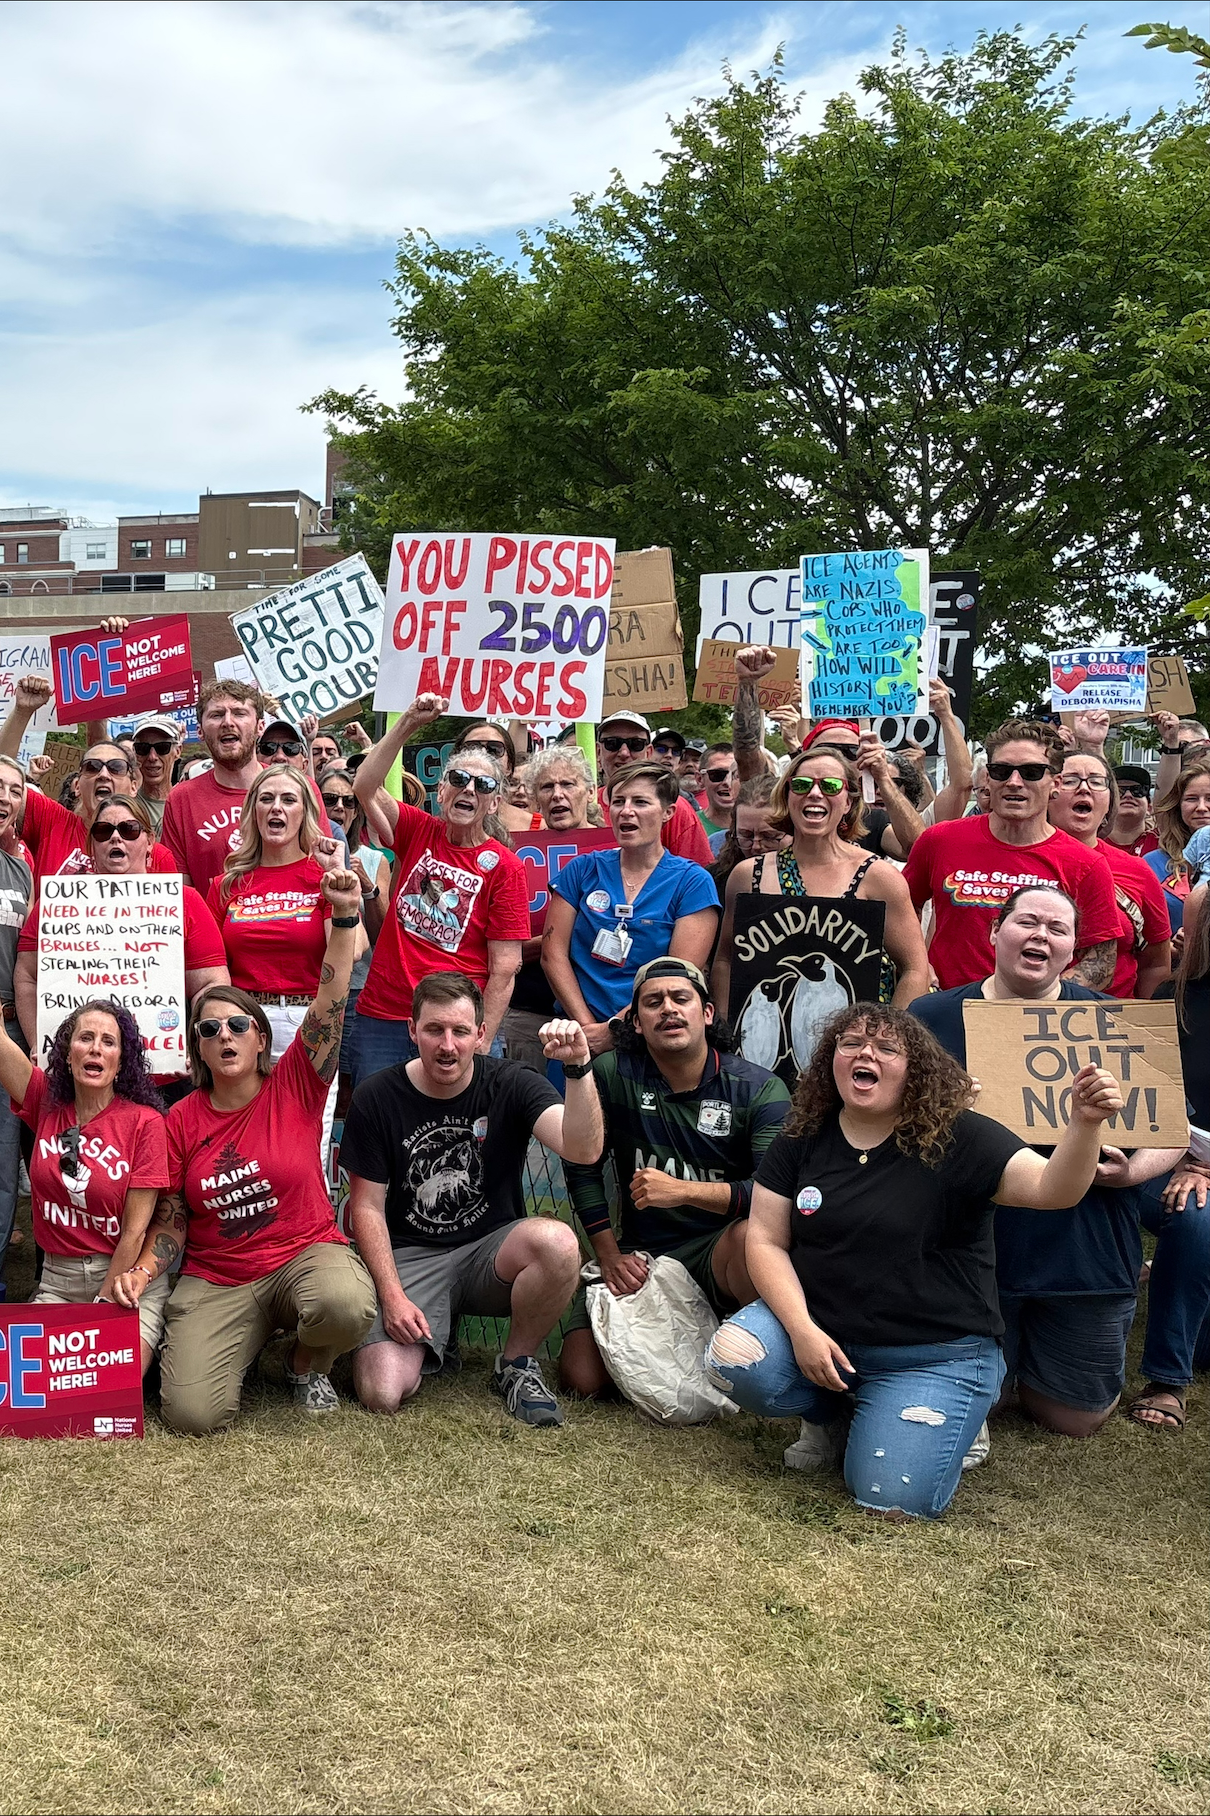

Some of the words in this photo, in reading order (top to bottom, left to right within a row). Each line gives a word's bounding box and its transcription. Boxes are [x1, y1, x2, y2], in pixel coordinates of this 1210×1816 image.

[396, 538, 471, 595] YOU
[484, 537, 613, 599] PISSED
[803, 557, 833, 580] ICE
[843, 551, 901, 574] AGENTS
[252, 595, 279, 614] TIME
[289, 583, 307, 596] FOR
[314, 567, 340, 584] SOME
[805, 584, 830, 600] ARE
[237, 571, 378, 663] PRETTI
[827, 600, 865, 620] COPS
[871, 602, 901, 618] WHO
[392, 600, 467, 656] OFF
[479, 600, 606, 656] 2500
[125, 634, 161, 656] NOT
[276, 620, 375, 683] GOOD
[835, 640, 864, 657] ARE
[127, 644, 186, 669] WELCOME
[816, 655, 850, 678] HOW
[857, 655, 903, 675] WILL
[1053, 652, 1080, 665] ICE
[1088, 652, 1121, 663] OUT
[58, 638, 126, 704] ICE
[128, 663, 162, 682] HERE!
[1088, 663, 1127, 675] CARE
[1130, 664, 1146, 675] IN
[278, 655, 380, 724] TROUB
[416, 656, 588, 719] NURSES
[810, 679, 872, 700] HISTORY
[1082, 689, 1122, 697] RELEASE
[814, 703, 872, 717] REMEMBER
[1061, 697, 1100, 706] DEBORA
[1102, 697, 1142, 706] KAPISHA
[421, 851, 457, 882] NURSES
[456, 872, 479, 892] FOR
[954, 869, 988, 884] Safe
[45, 880, 89, 899] OUR
[95, 879, 180, 899] PATIENTS
[237, 893, 263, 907] Safe
[962, 882, 1009, 898] Saves
[42, 906, 79, 918] NEED
[86, 905, 107, 918] ICE
[114, 906, 131, 918] IN
[133, 904, 179, 918] THEIR
[242, 903, 282, 915] Saves
[396, 897, 461, 942] DEMOCRACY
[41, 923, 81, 936] CUPS
[86, 923, 114, 935] AND
[119, 925, 140, 934] ON
[141, 923, 182, 937] THEIR
[734, 905, 881, 965] SOLIDARITY
[125, 941, 169, 953] NOT
[41, 958, 109, 972] STEALING
[110, 956, 160, 971] THEIR
[78, 972, 148, 989] NURSES!
[1022, 1005, 1129, 1042] ICE
[1025, 1044, 1145, 1082] OUT
[702, 1101, 731, 1111] PORTLAND
[402, 1119, 437, 1150] Racists
[442, 1115, 469, 1126] Ain't
[201, 1160, 261, 1191] MAINE
[203, 1179, 272, 1210] NURSES
[217, 1196, 280, 1221] UNITED
[462, 1202, 490, 1228] Holler
[49, 1329, 100, 1355] NOT
[49, 1348, 134, 1374] WELCOME
[49, 1371, 98, 1391] HERE!
